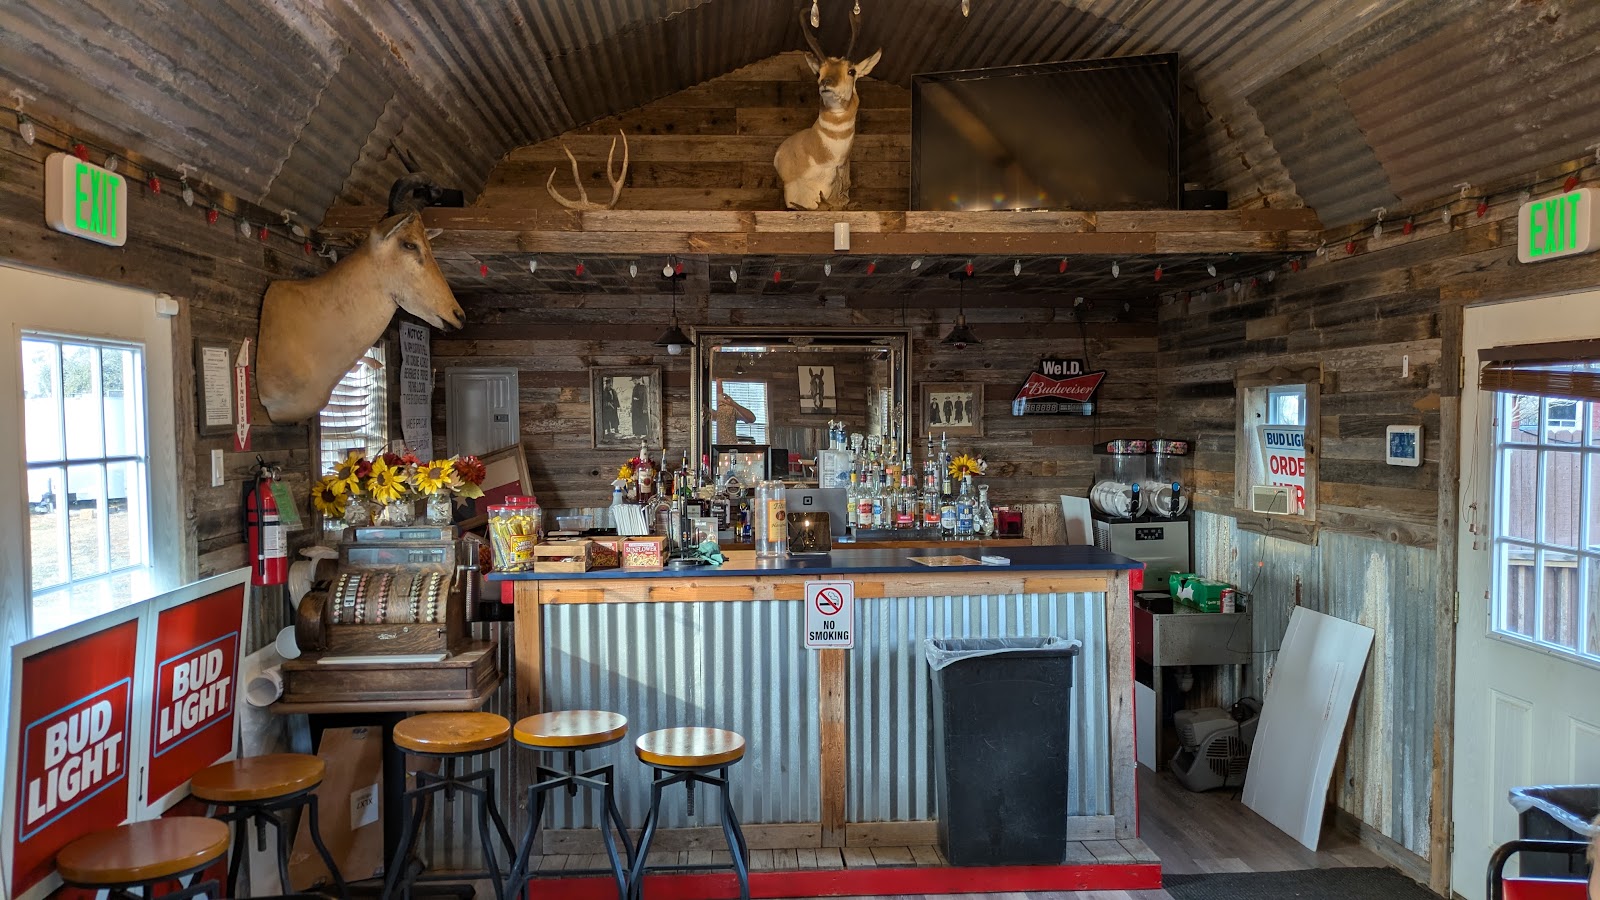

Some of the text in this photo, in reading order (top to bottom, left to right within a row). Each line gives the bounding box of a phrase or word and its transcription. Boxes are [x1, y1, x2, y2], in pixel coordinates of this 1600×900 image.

[75, 162, 119, 239] EXIT
[1529, 192, 1581, 257] EXIT
[407, 327, 423, 341] NOTICE
[1042, 361, 1061, 375] We
[1028, 381, 1093, 395] Budweiser
[1266, 432, 1304, 447] BUD LIG
[1269, 455, 1305, 477] ORDE
[625, 545, 657, 553] SUNFLOWER
[823, 620, 835, 630] NO
[809, 630, 849, 641] SMOKING
[172, 648, 223, 701] BUD
[159, 675, 231, 745] LIGHT
[44, 699, 113, 771] BUD
[27, 731, 122, 825] LIGHT
